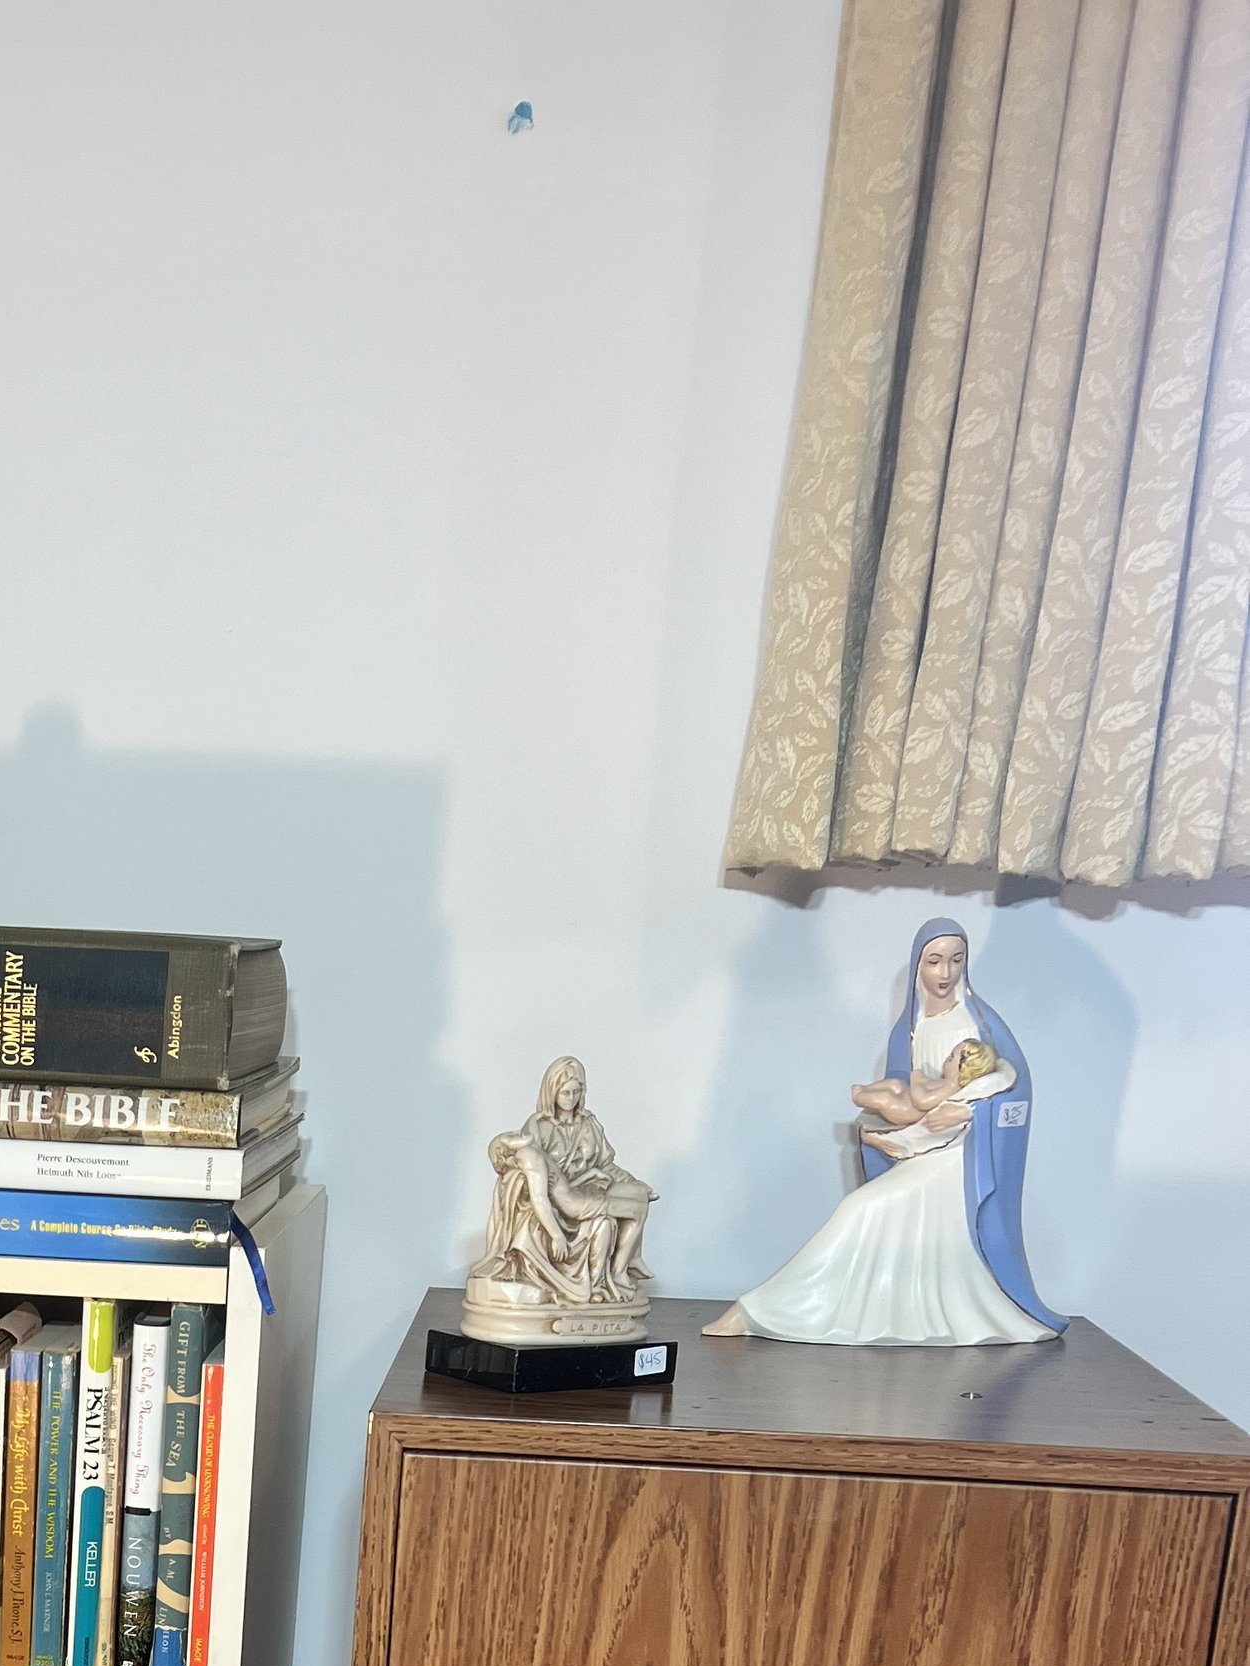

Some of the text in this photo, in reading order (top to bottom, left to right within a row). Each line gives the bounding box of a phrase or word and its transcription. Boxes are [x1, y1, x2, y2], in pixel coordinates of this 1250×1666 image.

[2, 950, 24, 1066] COMMENTARY
[166, 994, 182, 1060] Abingdon
[64, 1092, 181, 1132] BIBLE
[571, 1324, 584, 1332] LA
[638, 1351, 663, 1370] $45
[83, 1388, 104, 1481] PSALM 23
[84, 1541, 98, 1587] KELLER
[123, 1537, 143, 1637] NOUWEN
